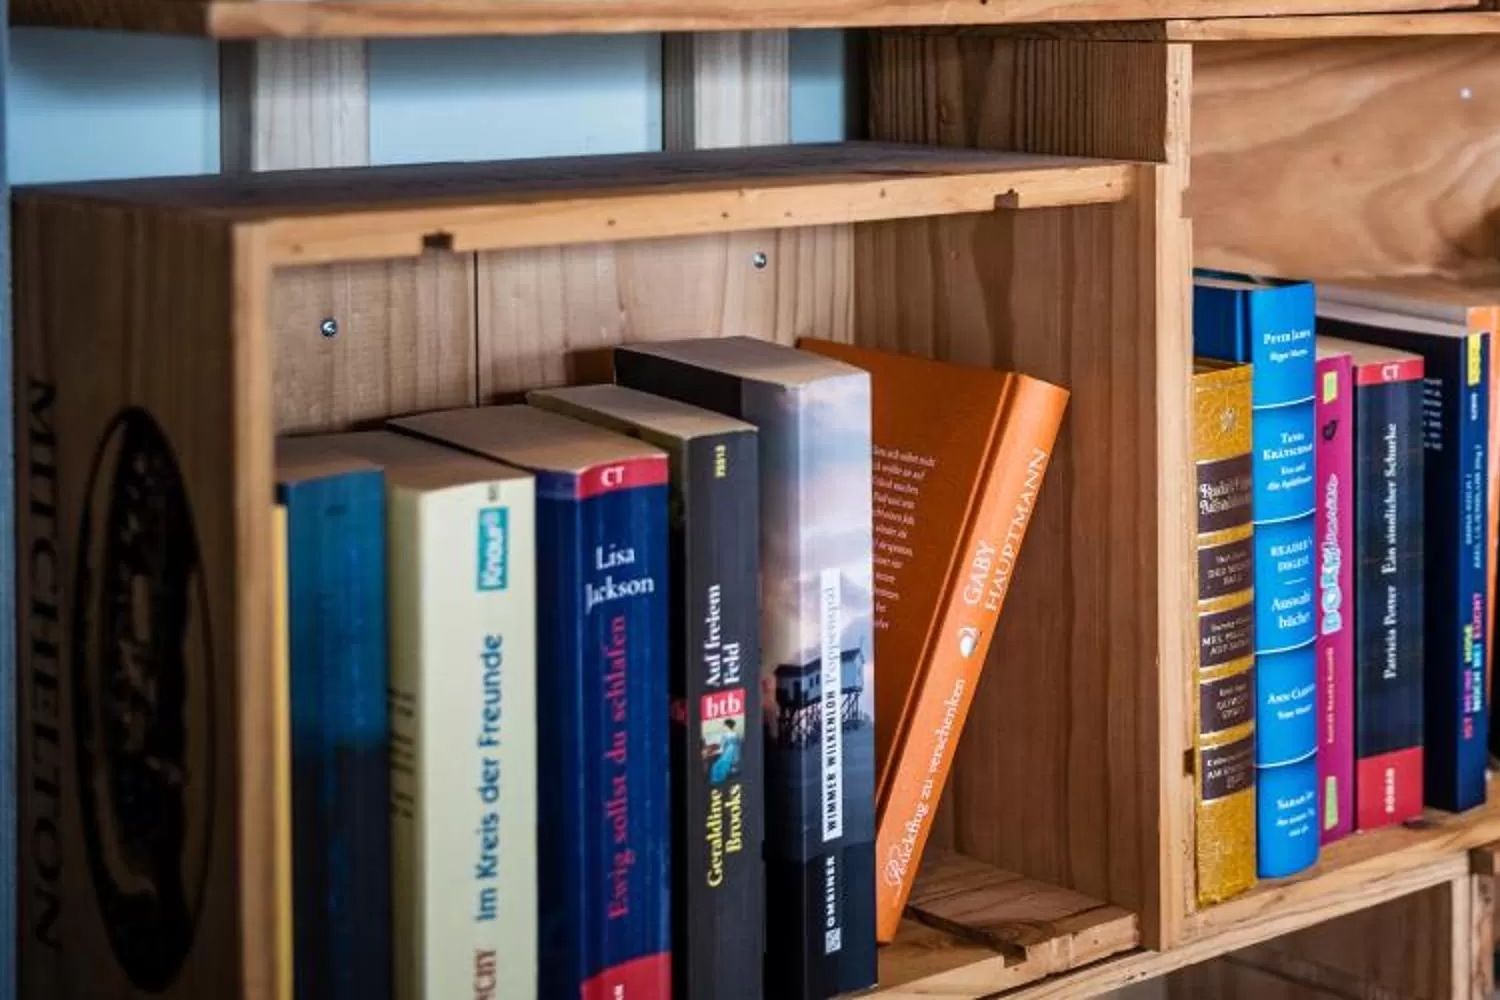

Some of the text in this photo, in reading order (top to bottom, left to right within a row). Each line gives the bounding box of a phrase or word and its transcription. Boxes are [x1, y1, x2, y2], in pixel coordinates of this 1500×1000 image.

[595, 542, 636, 570] Lisa
[964, 539, 996, 607] GABY
[985, 448, 1048, 613] HAUPTMANN
[1381, 423, 1398, 679] Patricia Potter Ein sinnlicher Schurke
[585, 575, 656, 609] Jackson
[703, 583, 722, 687] Auf freiem
[30, 376, 64, 950] MITCHELTON
[722, 641, 742, 685] Feld
[601, 615, 636, 921] Ewig sollst du schlafen
[823, 690, 838, 767] WILKENLOH
[929, 678, 966, 774] verschenken
[475, 634, 504, 922] Im Kreis der Freunde
[725, 784, 744, 853] Brooks
[825, 773, 838, 832] WIMMER
[705, 789, 725, 888] Geraldine
